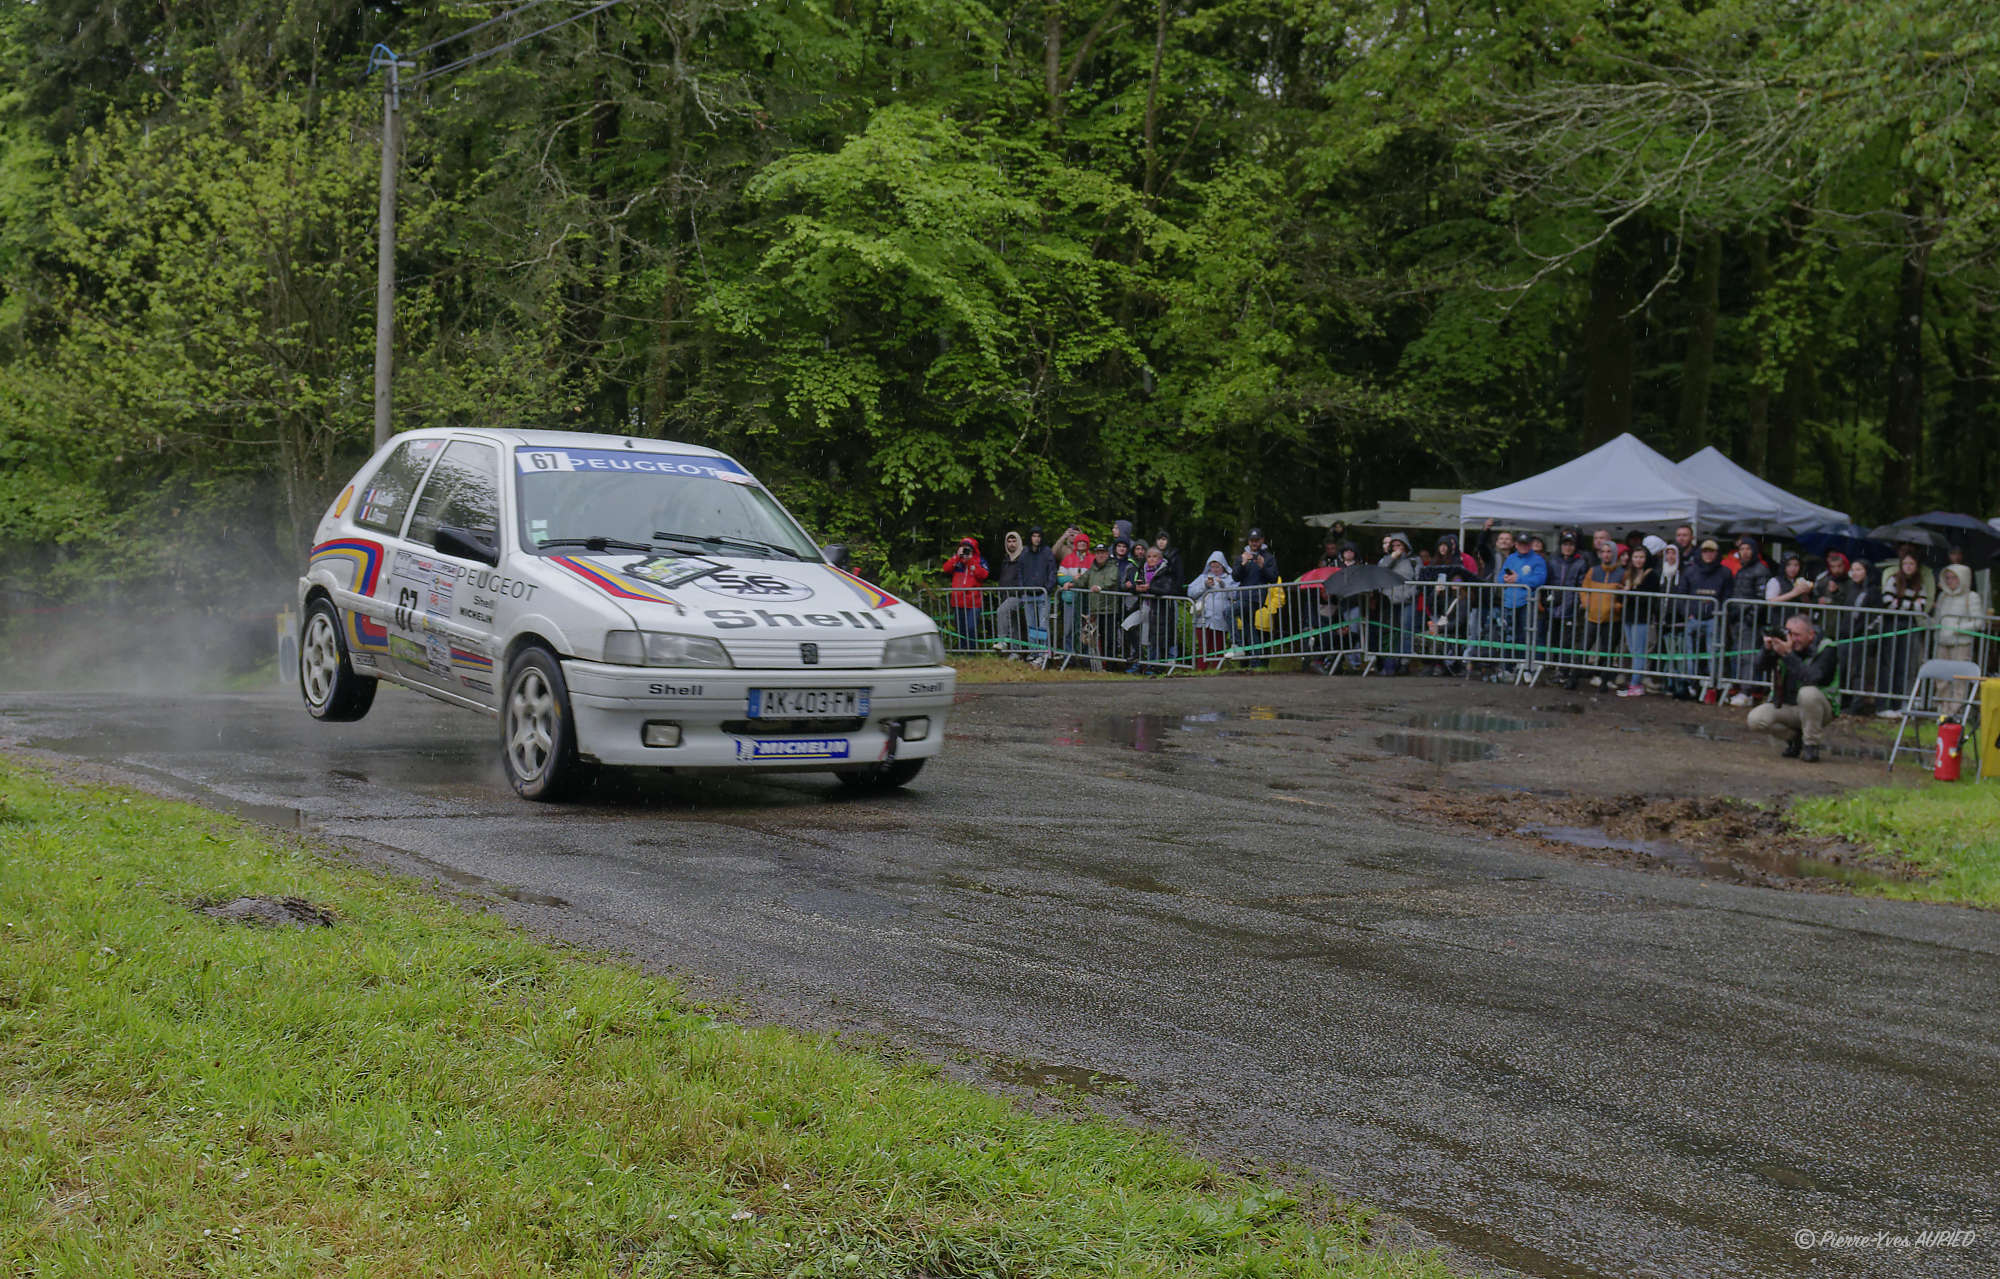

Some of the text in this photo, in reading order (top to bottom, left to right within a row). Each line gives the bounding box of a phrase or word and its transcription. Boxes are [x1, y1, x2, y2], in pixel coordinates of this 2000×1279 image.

[531, 453, 718, 477] 67 PEUGEOT
[456, 566, 539, 601] PEUGEOT
[709, 574, 791, 590] 56
[395, 586, 418, 633] 67
[473, 595, 495, 608] Shell
[459, 606, 494, 624] MICHELIN
[703, 609, 886, 631] Shell
[648, 683, 703, 696] Shell
[909, 681, 944, 694] Shell
[763, 692, 856, 714] AK-403-FM
[758, 741, 847, 754] MICHELIN
